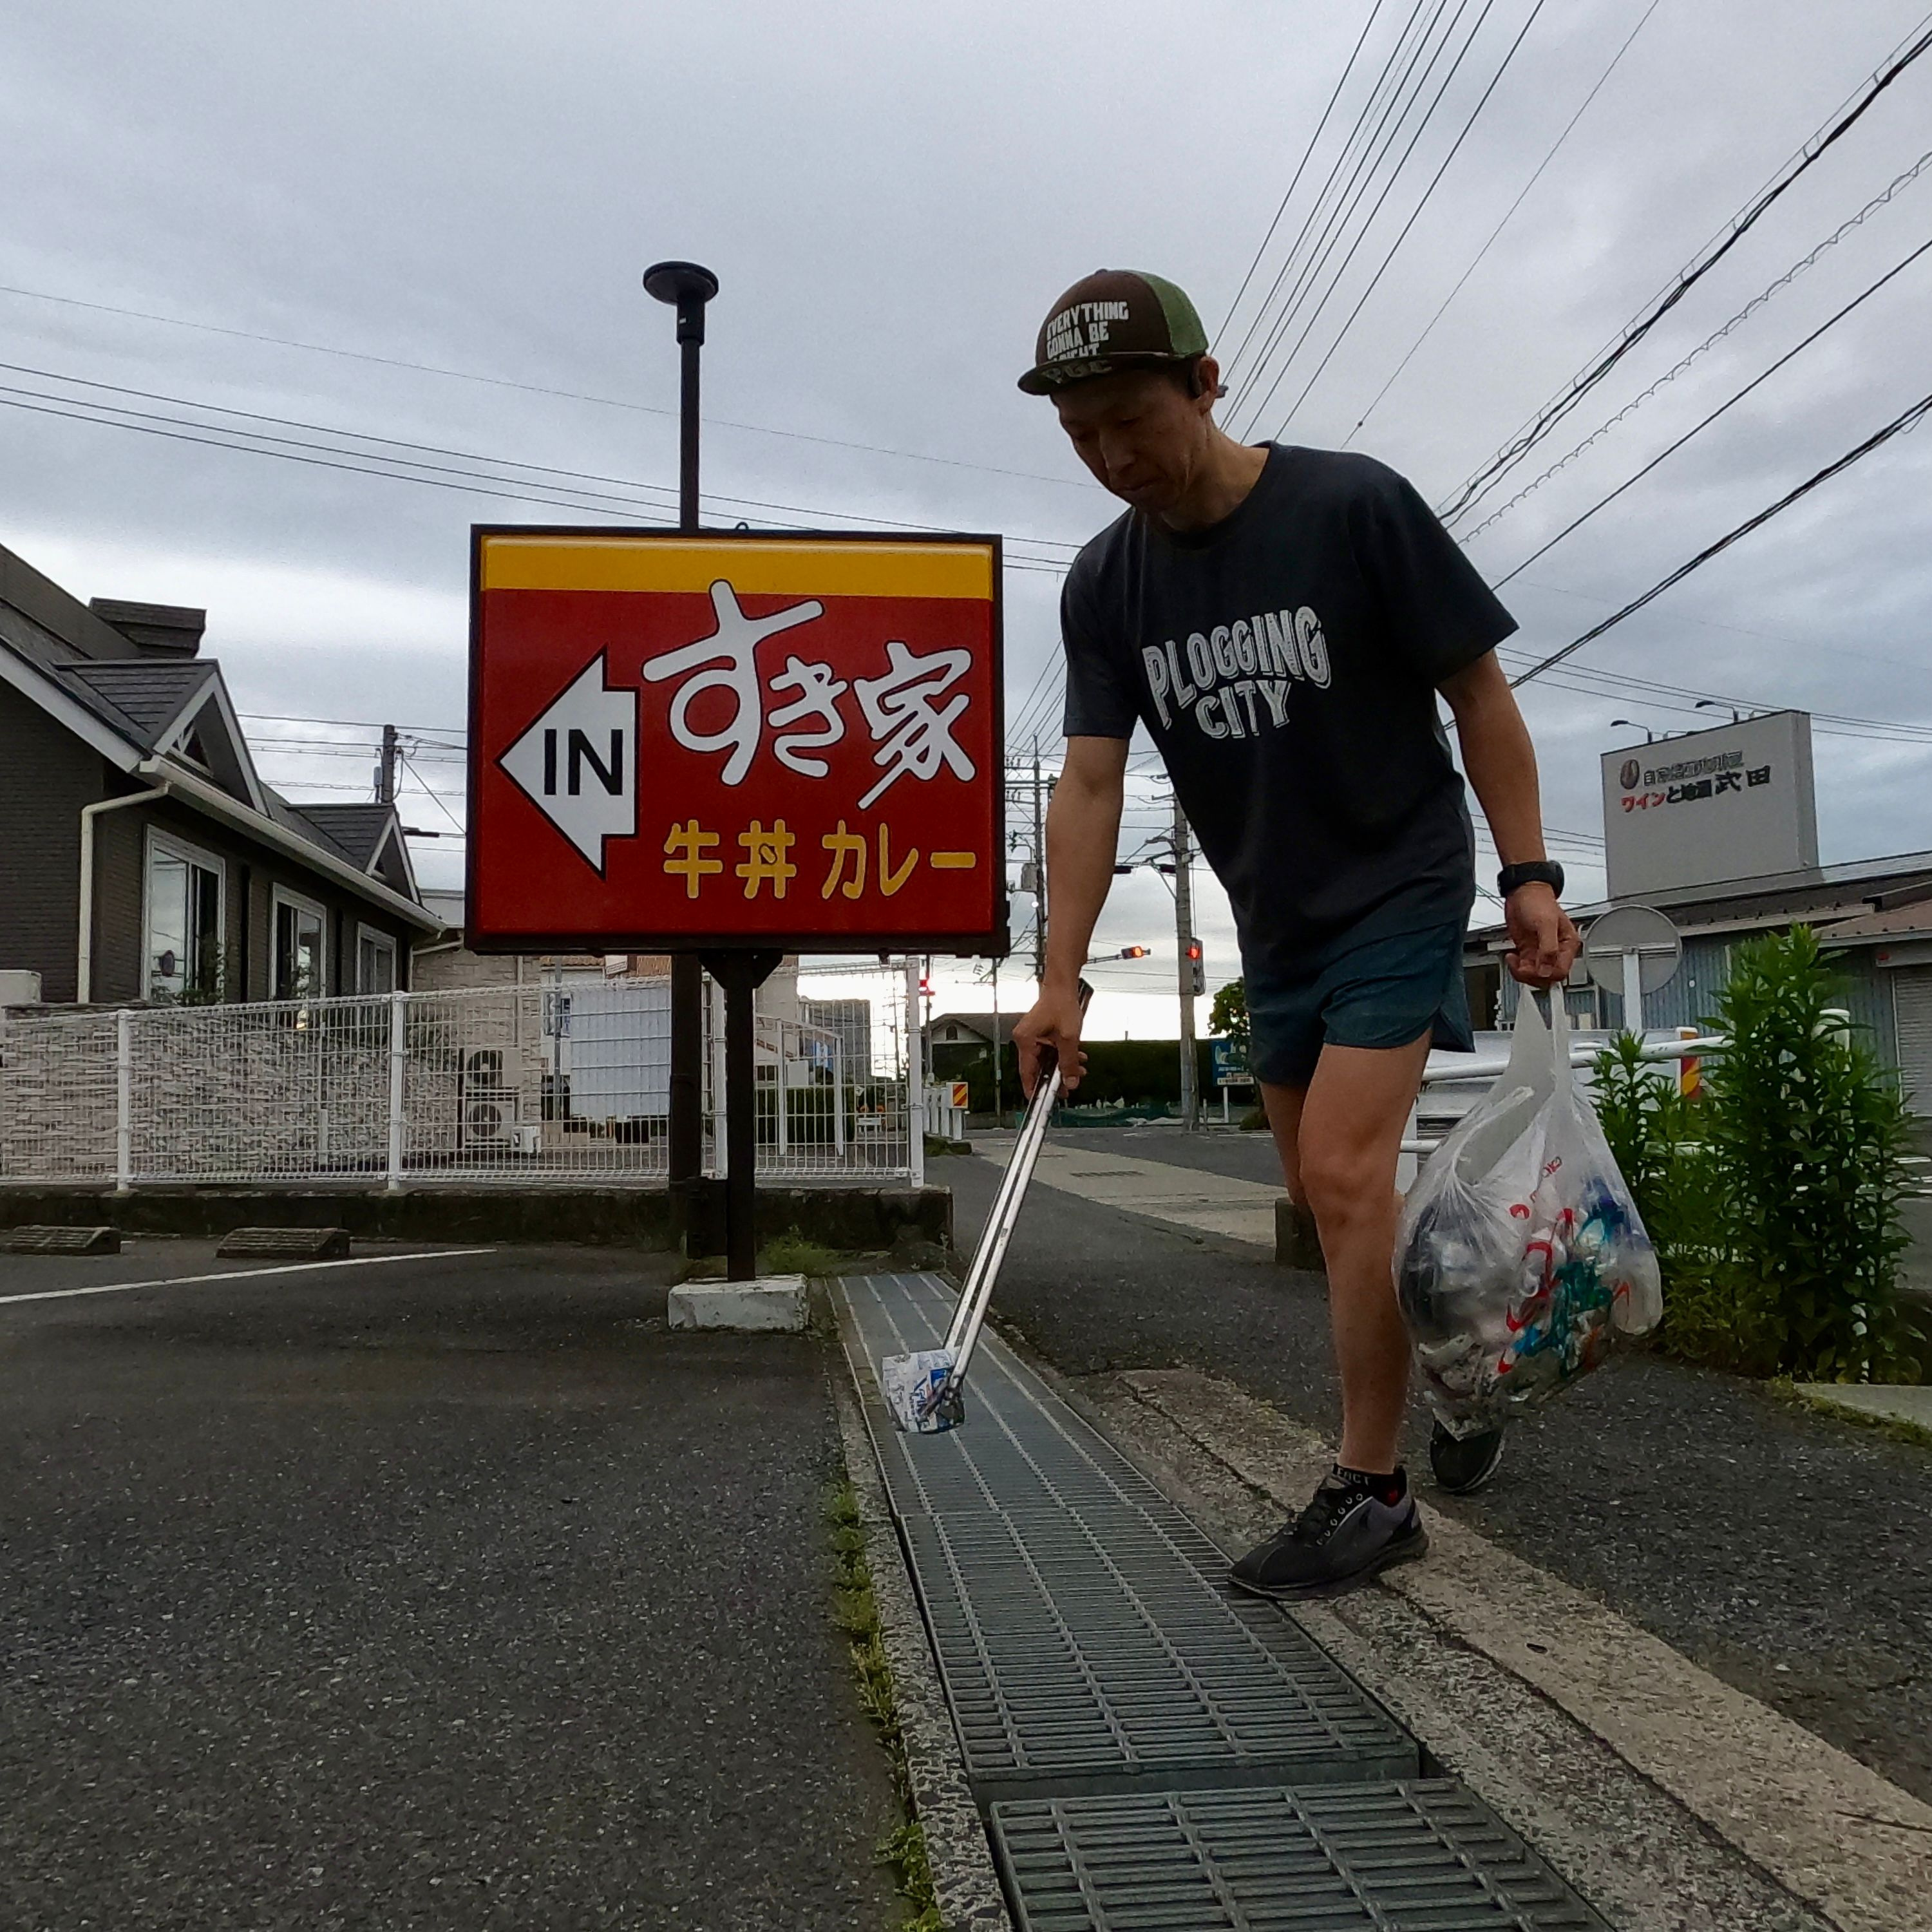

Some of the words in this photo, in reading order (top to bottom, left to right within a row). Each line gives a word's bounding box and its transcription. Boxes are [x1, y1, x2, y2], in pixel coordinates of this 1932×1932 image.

[1046, 301, 1130, 340] EVERYTHING
[1046, 327, 1083, 360] GONNA
[1088, 321, 1110, 343] BE
[641, 578, 976, 810] すき家
[1142, 605, 1331, 730] PLOGGING
[1195, 679, 1291, 739] CITY
[544, 728, 623, 796] IN
[663, 819, 797, 900] 牛丼
[821, 819, 976, 900] カレー
